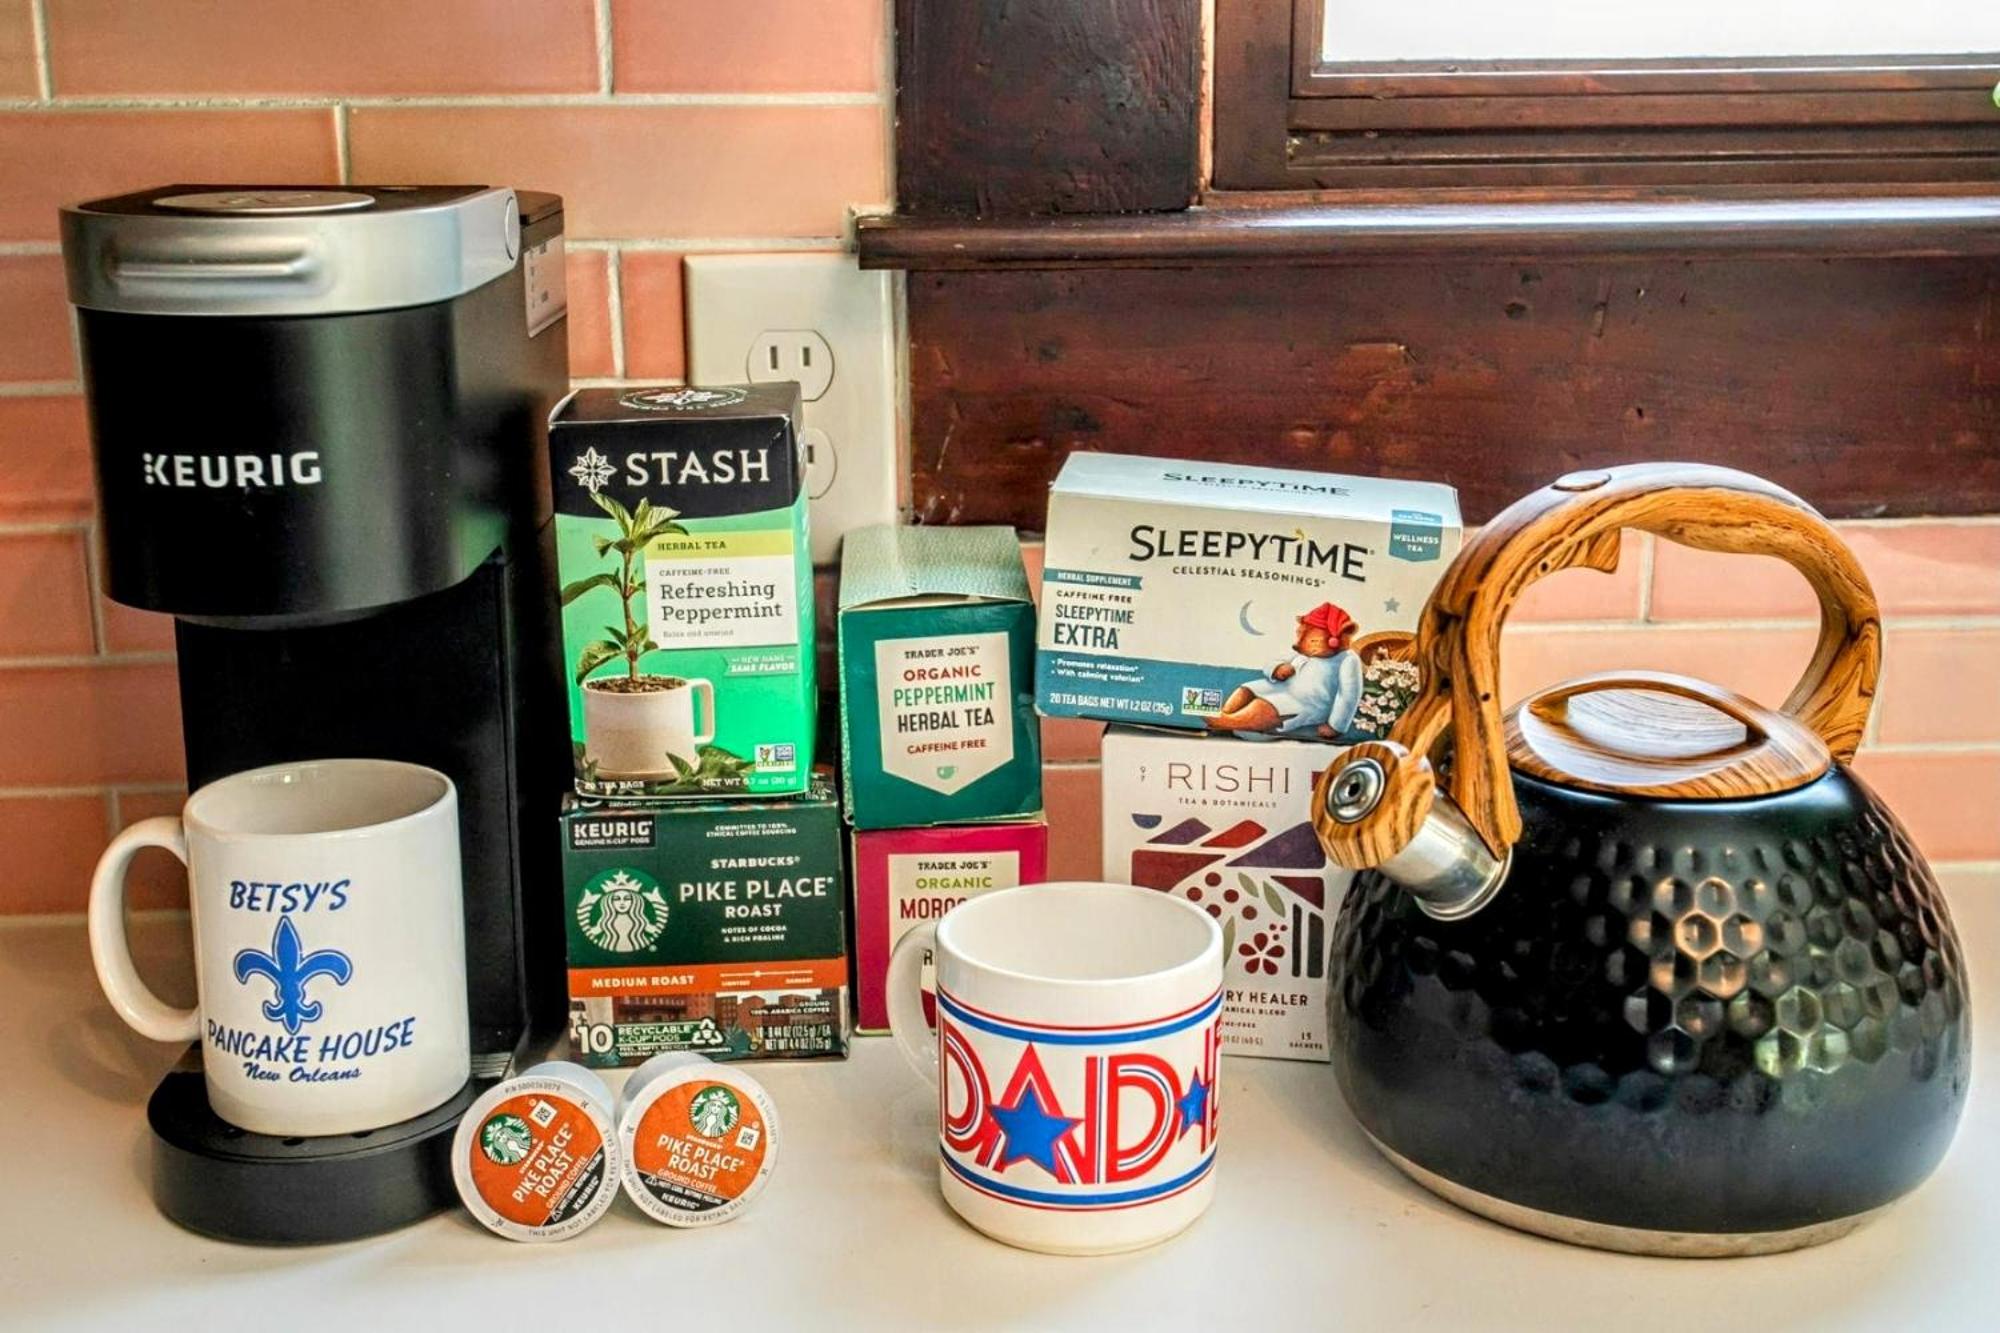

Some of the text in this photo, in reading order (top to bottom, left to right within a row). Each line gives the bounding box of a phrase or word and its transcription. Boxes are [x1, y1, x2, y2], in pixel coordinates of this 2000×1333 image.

[143, 451, 322, 488] KEURIG
[626, 448, 771, 487] STASH
[1163, 472, 1353, 497] SLEEPYTIME
[658, 541, 727, 551] HERBAL TEA
[1393, 533, 1440, 545] WELLNESS
[1129, 524, 1370, 583] SLEEPYTIME
[1407, 544, 1424, 553] TEA
[659, 567, 731, 577] CAFFEINE-FREE
[1057, 572, 1132, 586] HERBAL SUPPLEMENT
[1172, 565, 1322, 588] CELESTIAL SEASONINGS
[660, 580, 776, 600] Refreshing
[1056, 589, 1133, 604] CAFFEINE FREE
[661, 601, 783, 624] Peppermint
[1055, 603, 1135, 625] SLEEPYTIME
[1053, 622, 1119, 650] EXTRA
[904, 646, 978, 659] TRADER JOE'S
[731, 662, 795, 673] SAME FLAVOR
[1056, 658, 1096, 669] Promotes
[903, 664, 982, 682] ORGANIC
[893, 682, 995, 708] PEPPERMINT
[1049, 692, 1061, 704] 20
[1061, 693, 1077, 705] TEA
[1077, 694, 1099, 707] BAGS
[1100, 696, 1116, 708] NET
[1116, 698, 1130, 710] WT
[897, 707, 995, 733] HERBAL TEA
[907, 738, 987, 754] CAFFEINE FREE
[723, 777, 742, 786] WT
[1167, 762, 1291, 794] RISHI
[1178, 797, 1198, 806] TEA
[1212, 799, 1278, 809] BOTANICALS
[573, 821, 653, 838] KEURIG
[706, 828, 797, 838] ETHICAL COFFEE SOURCING
[714, 824, 757, 832] COMMITTED
[630, 836, 650, 845] PODS
[711, 856, 798, 869] STARBUCKS
[917, 860, 991, 872] TRADER JOE'S
[679, 876, 831, 903] PIKE PLACE
[916, 876, 993, 890] ORGANIC
[229, 879, 351, 913] BETSY'S
[724, 904, 783, 919] ROAST
[721, 925, 788, 934] NOTES OF COCOA
[731, 935, 751, 943] RICH
[752, 934, 786, 942] PRALINE
[592, 975, 696, 989] MEDIUM ROAST
[1226, 990, 1309, 1007] RY HEALER
[1224, 1006, 1287, 1016] ANICAL BLEND
[618, 1024, 692, 1036] RECYCLABLE
[1223, 1021, 1256, 1029] NE-FREE
[207, 1016, 416, 1064] PANCAKE HOUSE
[576, 1024, 615, 1054] 10
[652, 1033, 681, 1043] PODS
[1288, 1041, 1323, 1050] SACHETS
[242, 1061, 362, 1083] New Orleans
[657, 1133, 742, 1172] PIKE PLACE
[511, 1127, 573, 1203] PIKE PLACE
[667, 1153, 719, 1181] ROAST
[534, 1150, 574, 1198] ROAST
[545, 1179, 571, 1208] GROUND
[566, 1155, 589, 1181] COFFEE
[657, 1167, 692, 1186] GROUND
[690, 1180, 719, 1194] COFFEE
[572, 1175, 600, 1211] KEURIG
[661, 1192, 700, 1210] KEURIG
[528, 1229, 547, 1237] THIS
[568, 1219, 582, 1231] NOT
[583, 1193, 609, 1223] LABELED
[651, 1202, 685, 1221] LABELED
[685, 1213, 701, 1223] FOR
